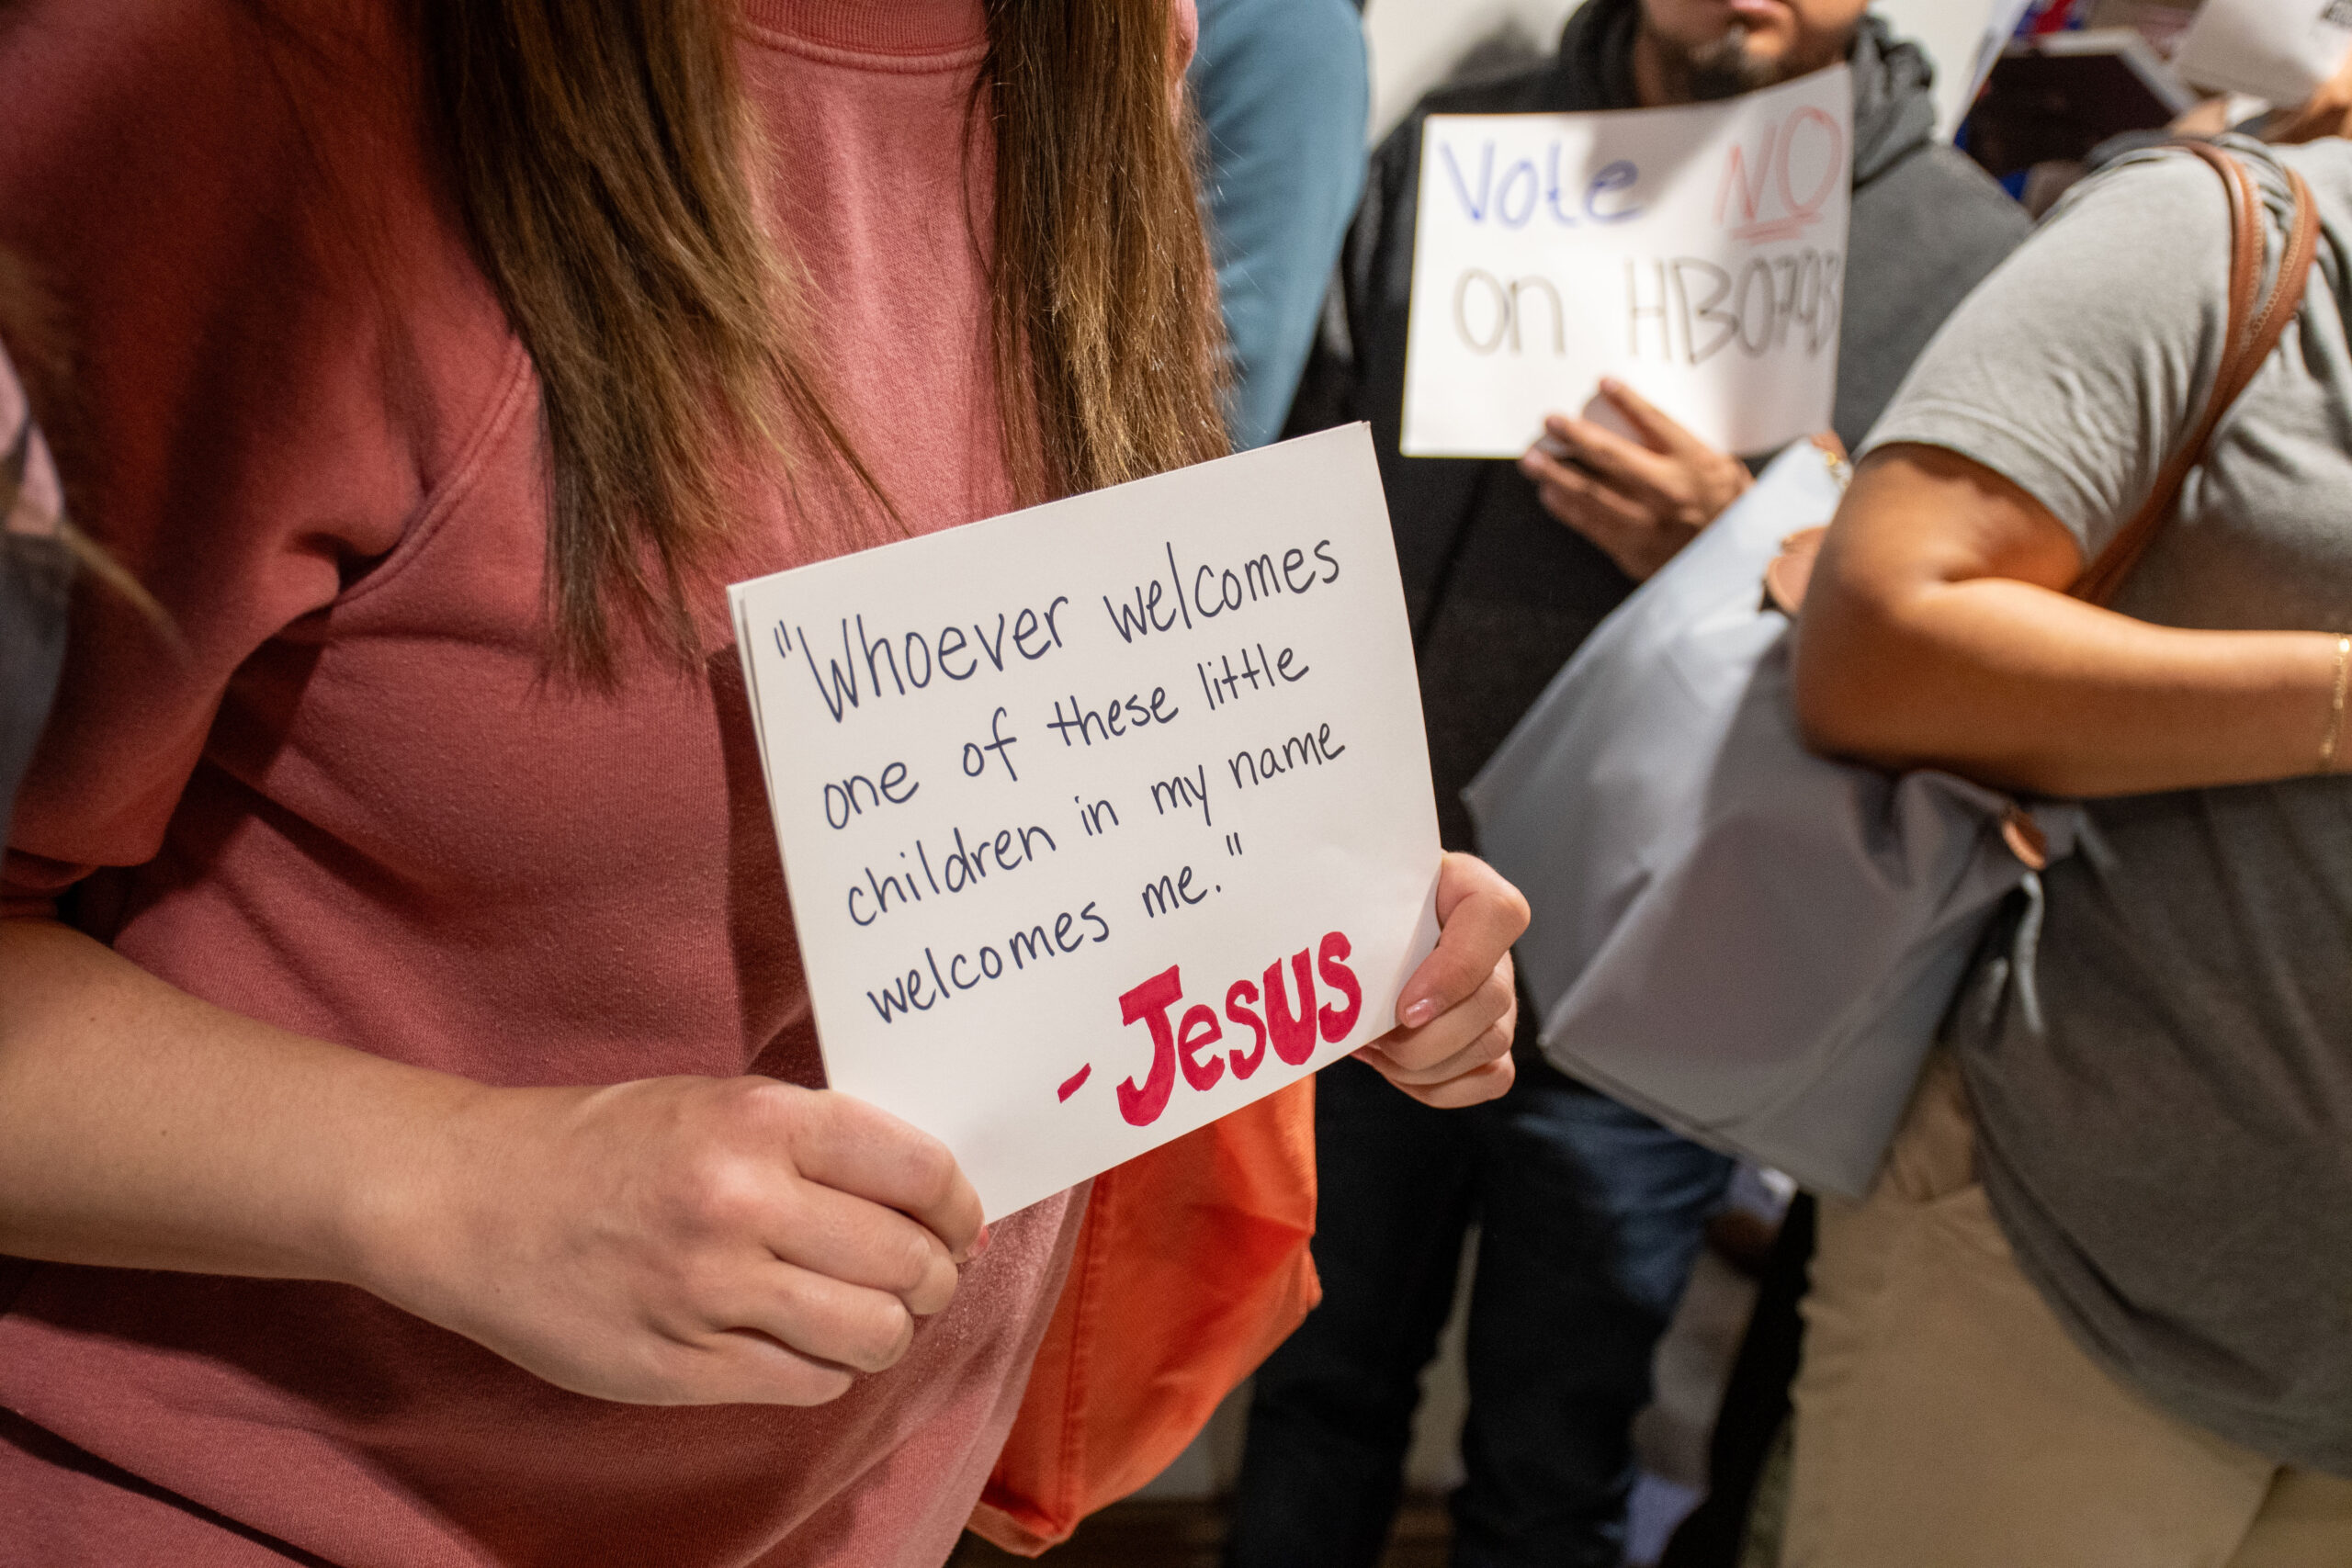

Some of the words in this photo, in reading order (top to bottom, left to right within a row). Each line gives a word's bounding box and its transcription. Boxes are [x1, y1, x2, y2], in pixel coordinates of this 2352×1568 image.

[1438, 138, 1646, 230] Vote
[1711, 104, 1845, 228] NO
[1453, 266, 1567, 356] on
[774, 594, 1069, 725] "Whoever
[1102, 539, 1340, 644] welcomes
[823, 761, 921, 830] one
[962, 706, 1018, 782] of
[1046, 685, 1180, 747] these
[1197, 642, 1310, 711] little
[848, 826, 1057, 927] children
[1074, 795, 1119, 838] in
[1150, 764, 1212, 828] my
[1227, 722, 1347, 790] name
[866, 901, 1111, 1024] welcomes
